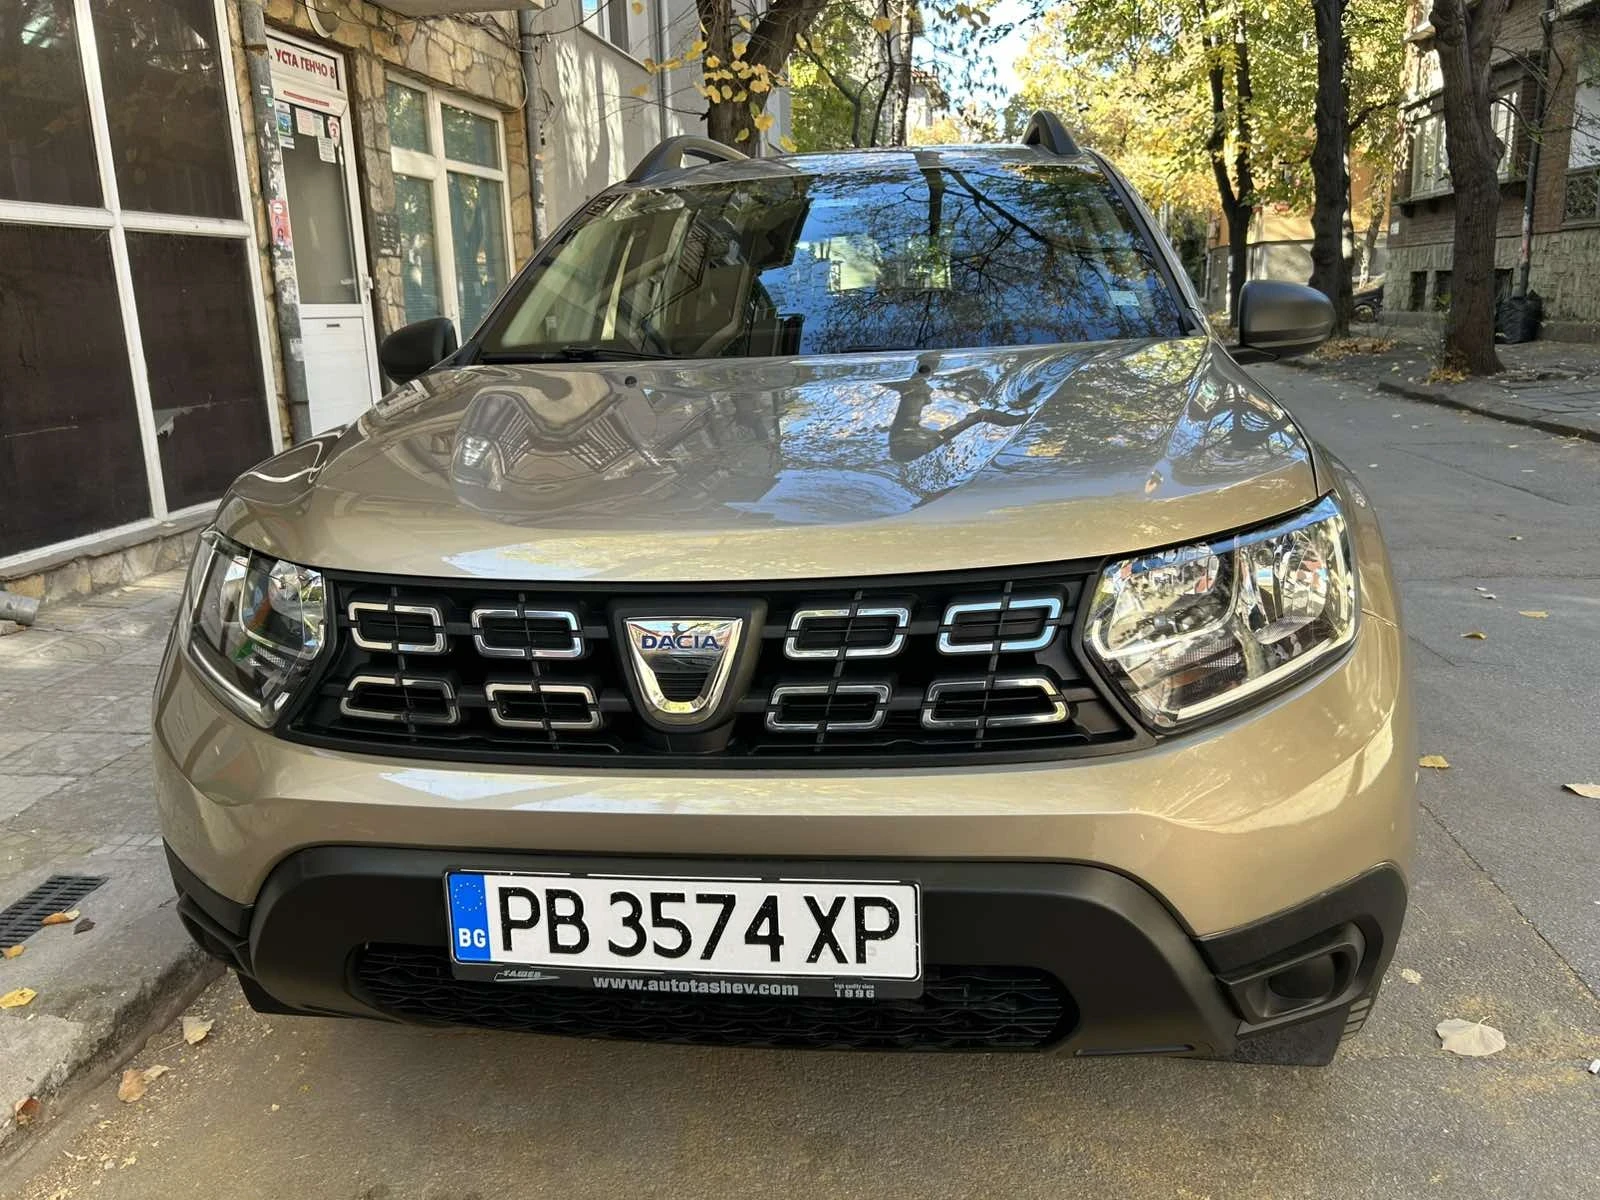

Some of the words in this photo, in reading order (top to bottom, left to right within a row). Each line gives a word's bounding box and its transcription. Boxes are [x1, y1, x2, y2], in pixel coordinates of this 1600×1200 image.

[275, 48, 299, 68] УСТА
[300, 57, 328, 77] ГЕНЧО
[641, 635, 719, 650] DACIA
[497, 886, 590, 955] PB
[607, 891, 784, 963] 3574
[803, 895, 901, 965] XP
[459, 928, 486, 948] BG
[592, 976, 799, 996] www.autotashev.com
